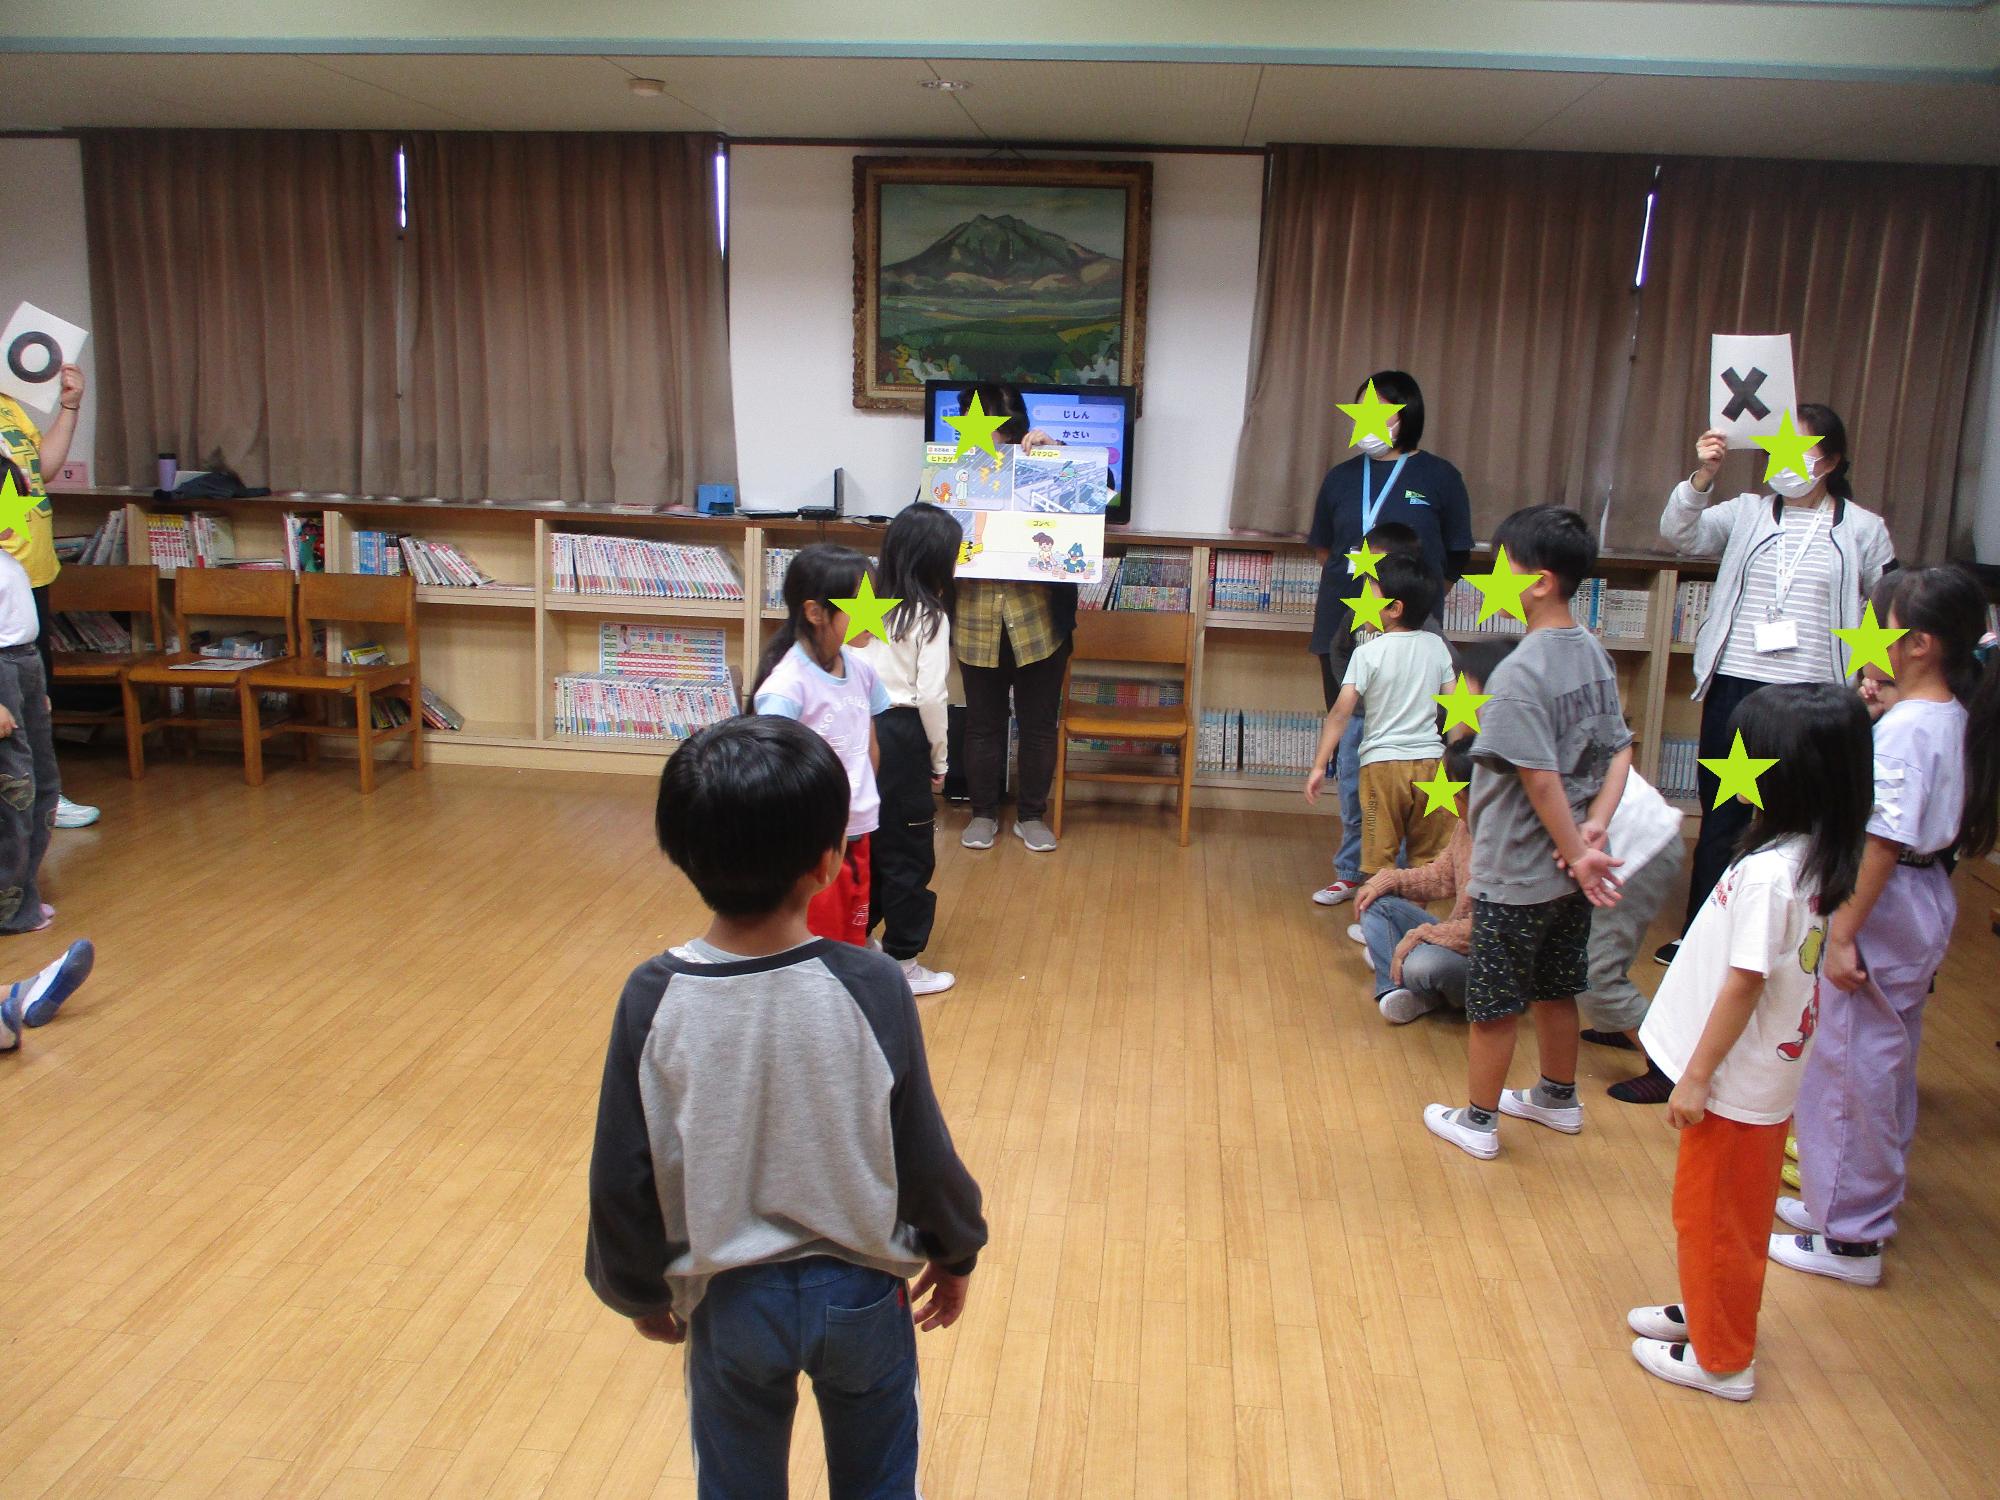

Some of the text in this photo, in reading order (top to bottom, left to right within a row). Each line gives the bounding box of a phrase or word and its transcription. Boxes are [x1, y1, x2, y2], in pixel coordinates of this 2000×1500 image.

[1063, 410, 1090, 420] じしん
[1062, 429, 1090, 439] かさい
